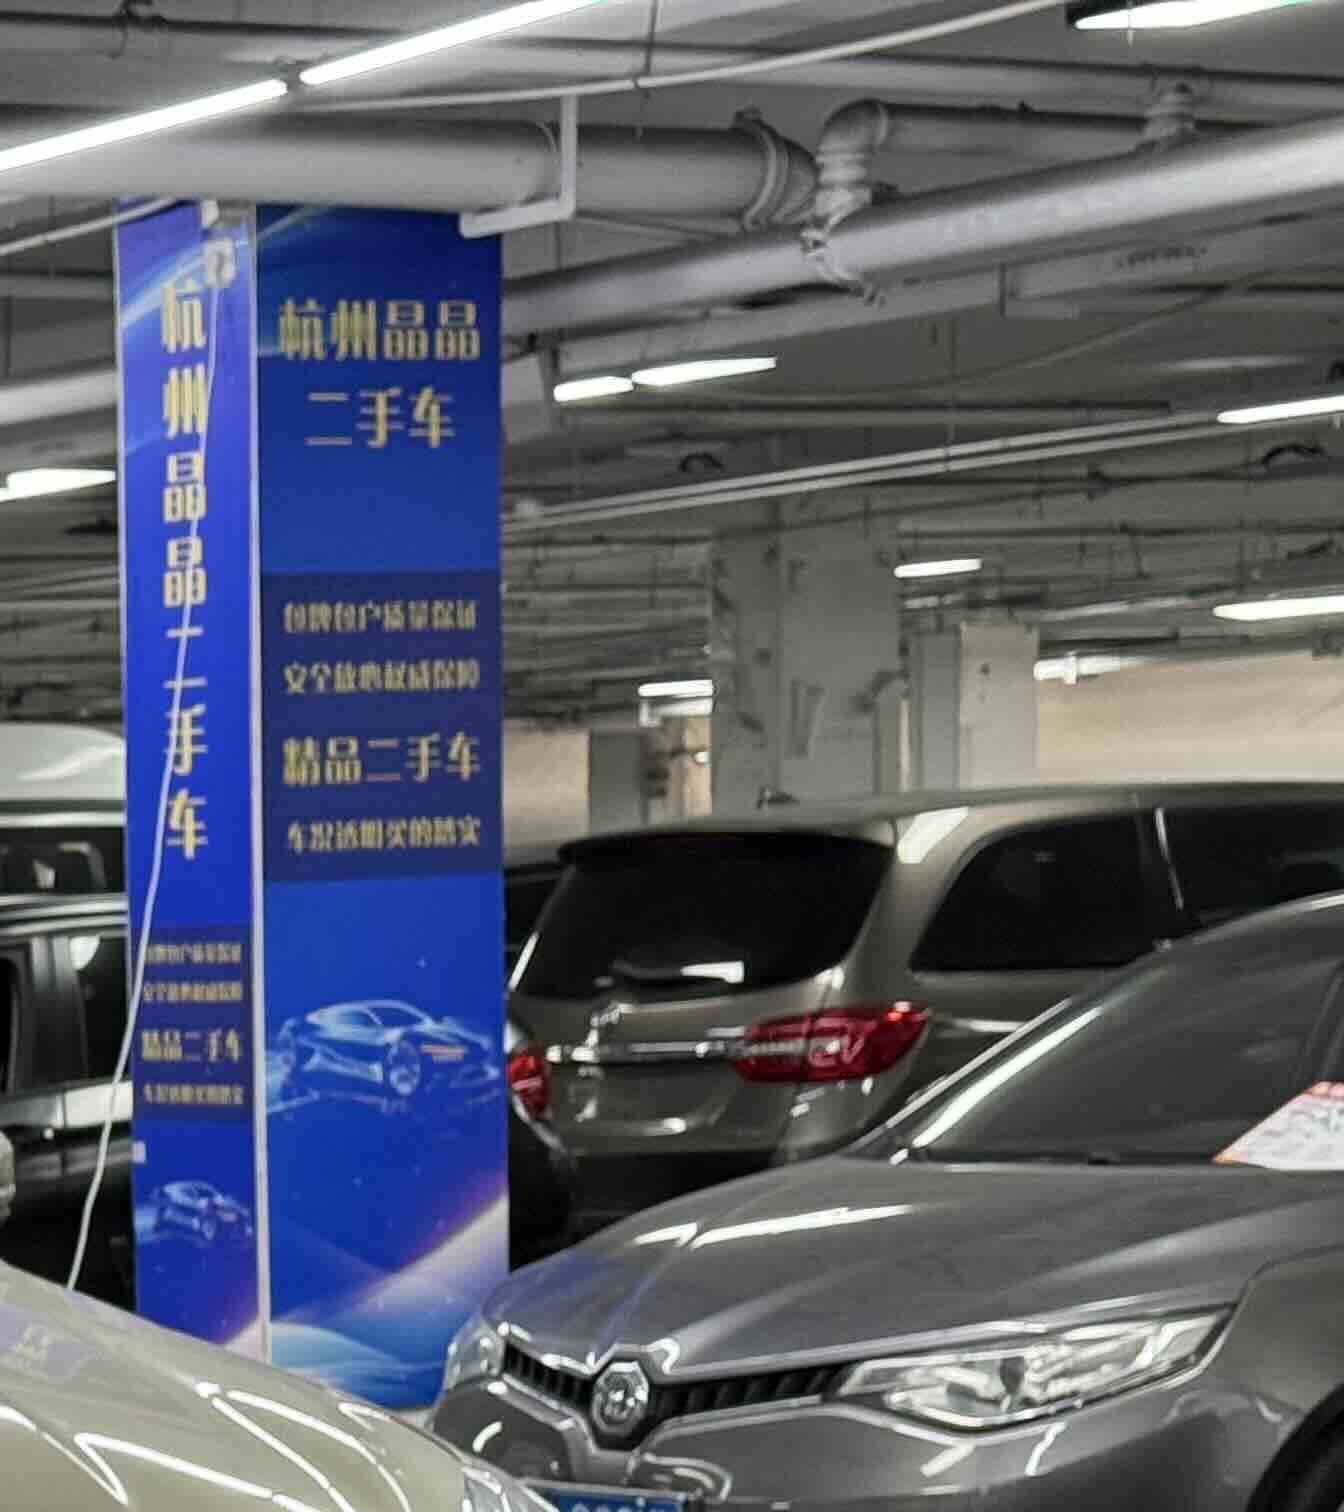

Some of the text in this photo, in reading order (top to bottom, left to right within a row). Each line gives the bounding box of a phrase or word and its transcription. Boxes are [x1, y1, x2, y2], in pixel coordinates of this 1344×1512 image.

[279, 298, 481, 361] 杭州晶晶
[305, 386, 456, 449] 二手车
[282, 731, 481, 787] 精品二手车
